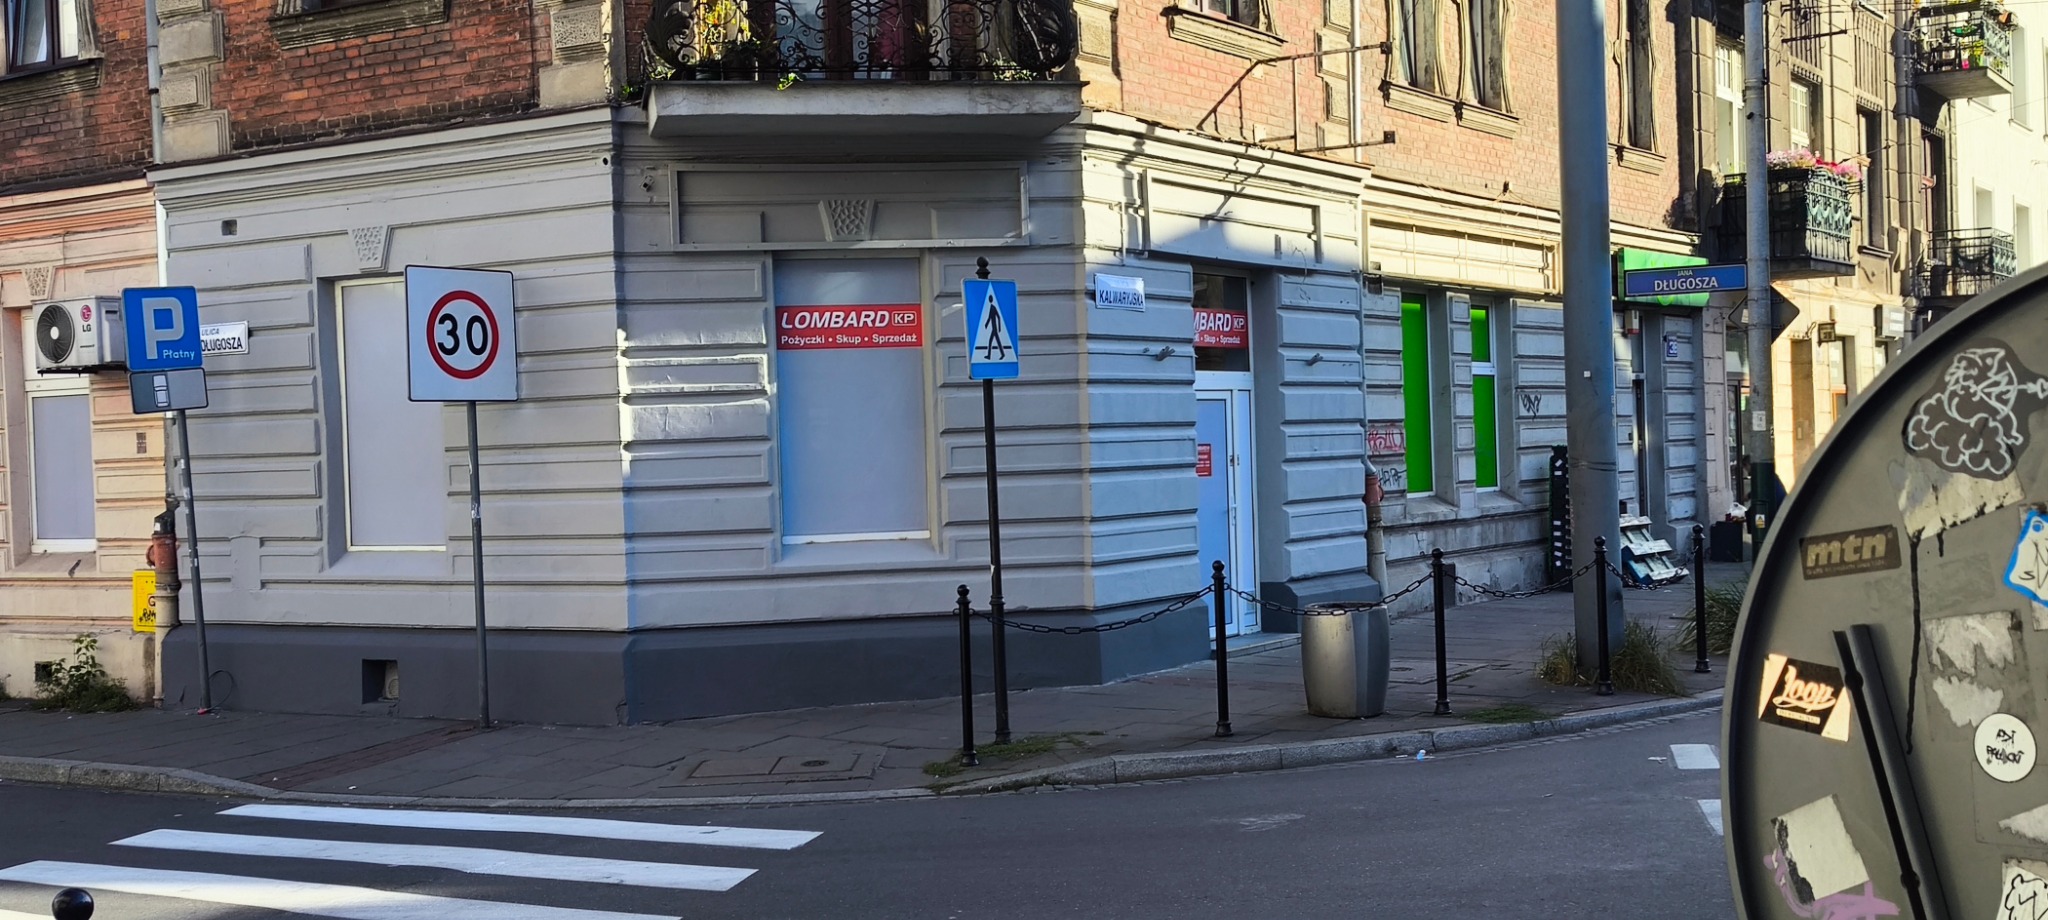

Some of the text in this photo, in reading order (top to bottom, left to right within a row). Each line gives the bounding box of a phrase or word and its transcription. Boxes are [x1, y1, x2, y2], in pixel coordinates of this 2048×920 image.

[1677, 269, 1693, 277] JANA
[1654, 277, 1719, 292] DŁUGOSZA
[1100, 290, 1144, 306] KALWARYJSKA
[781, 310, 916, 329] LOMBARD KP
[1233, 317, 1245, 329] KP
[82, 323, 92, 332] LG
[142, 297, 185, 360] P
[437, 312, 488, 356] 30
[781, 333, 917, 346] Pożyczki Skup Sprzedaż
[163, 349, 195, 361] Płatny
[1806, 534, 1887, 570] mtn
